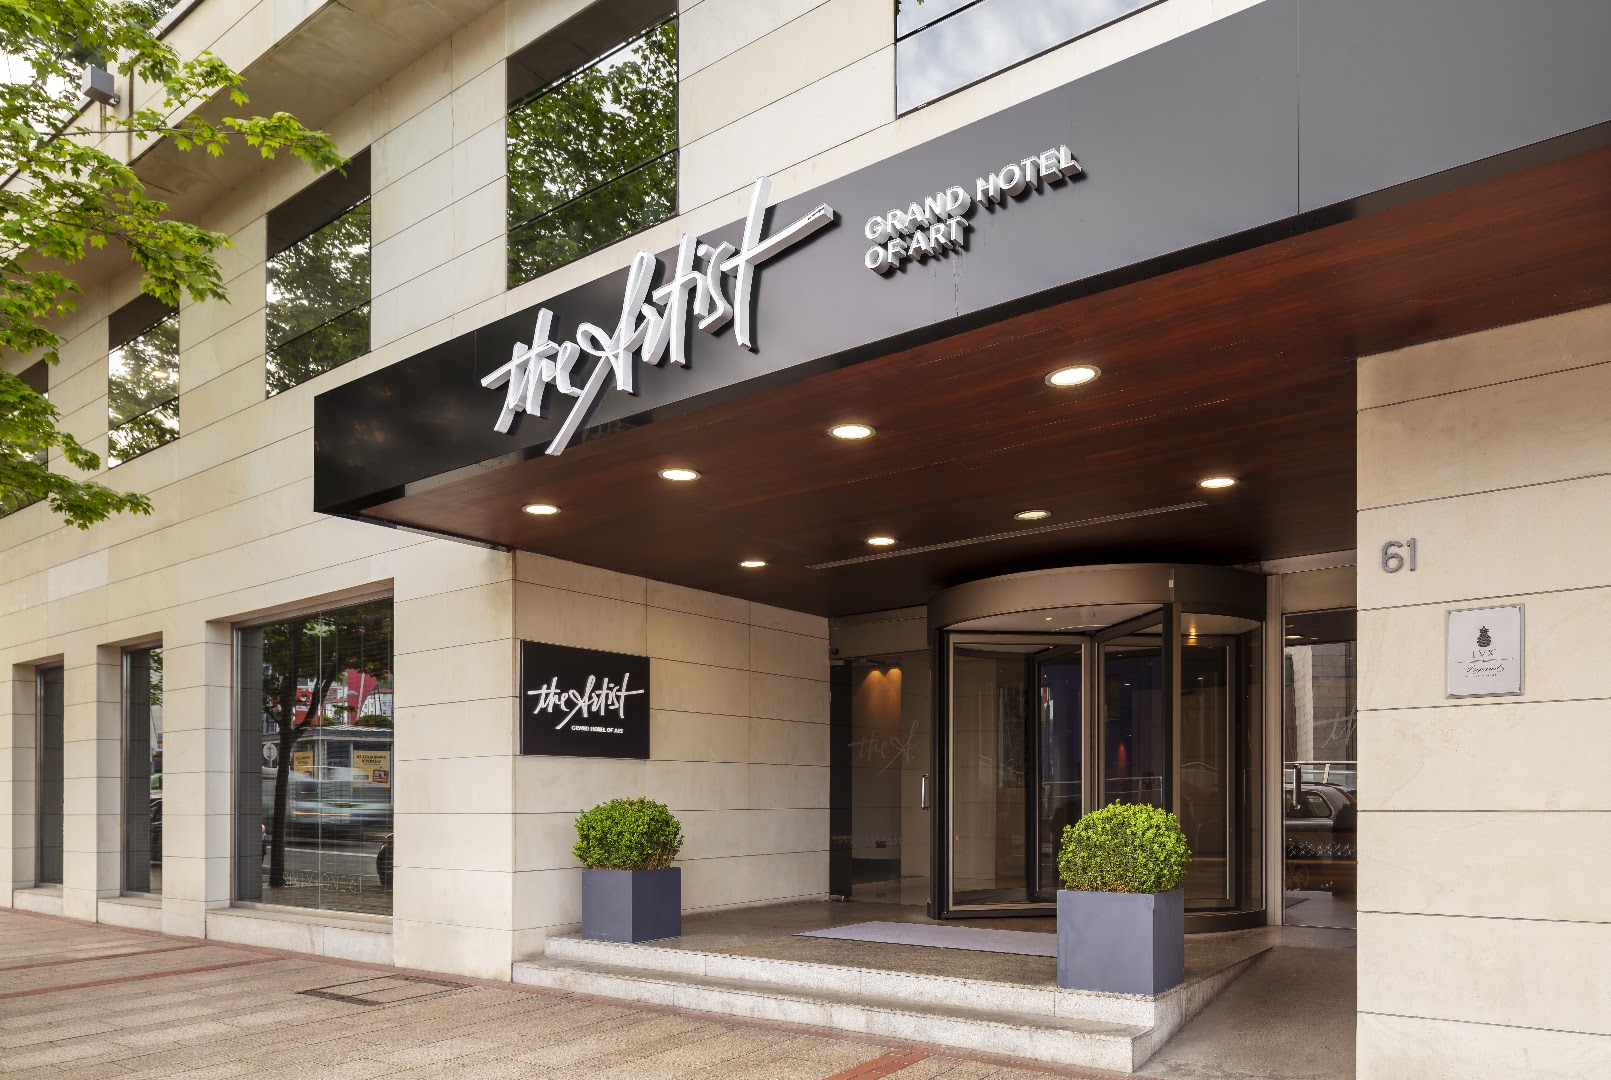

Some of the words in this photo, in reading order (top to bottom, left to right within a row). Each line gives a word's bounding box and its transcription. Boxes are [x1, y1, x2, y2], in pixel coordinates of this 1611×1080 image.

[864, 185, 972, 245] GRAND
[975, 144, 1082, 208] HOTEL
[864, 237, 907, 275] OF
[908, 215, 969, 262] ART
[1381, 537, 1417, 574] 61
